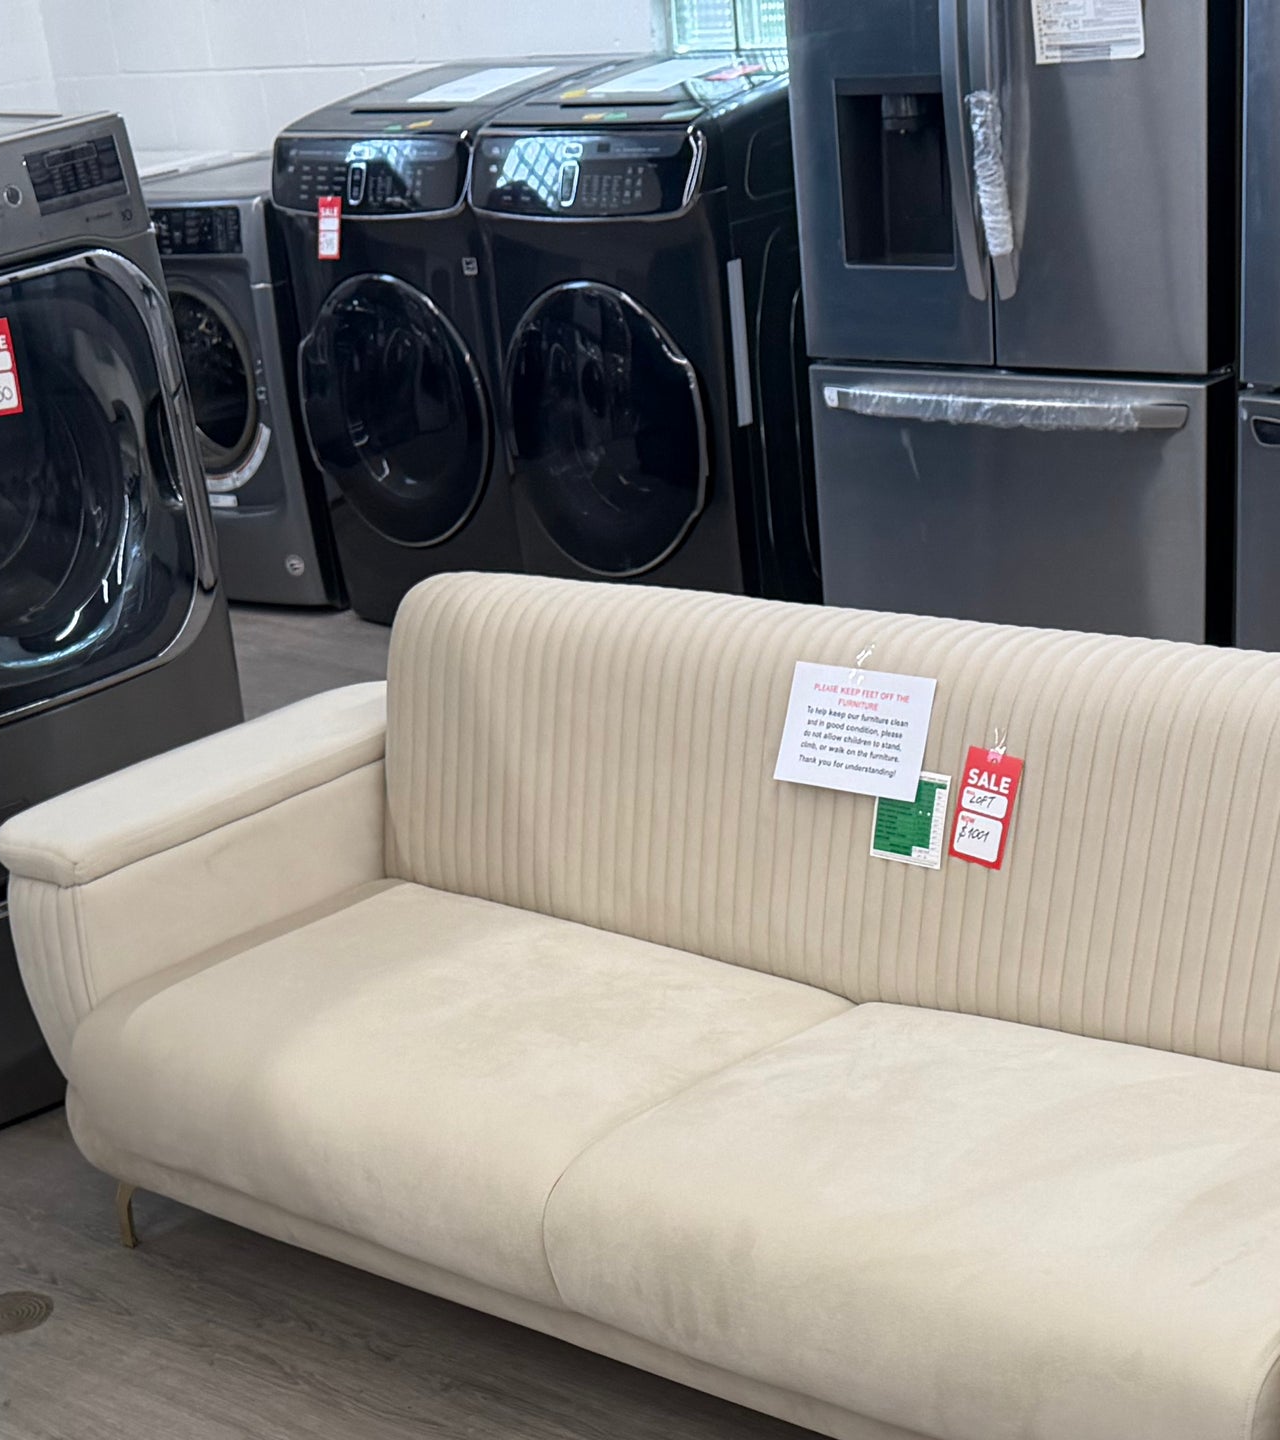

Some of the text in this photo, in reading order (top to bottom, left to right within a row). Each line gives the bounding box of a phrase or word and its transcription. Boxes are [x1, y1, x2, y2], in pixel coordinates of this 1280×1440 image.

[814, 683, 910, 703] PLEASE KEEP FEET OFF THE
[838, 698, 879, 711] FURNITURE
[807, 705, 814, 714] To
[815, 706, 827, 716] help
[829, 708, 846, 719] keep
[860, 712, 889, 725] furniture
[890, 717, 909, 727] clean
[819, 719, 825, 727] in
[826, 720, 845, 730] good
[846, 722, 880, 736] condition,
[880, 729, 903, 739] please
[803, 729, 902, 752] do not allow children to stand,
[800, 741, 817, 751] climb,
[828, 745, 844, 754] walk
[846, 748, 856, 756] on
[857, 749, 868, 758] the
[869, 751, 900, 763] furniture.
[798, 754, 897, 778] Thank you for understanding!
[967, 768, 1012, 794] SALE
